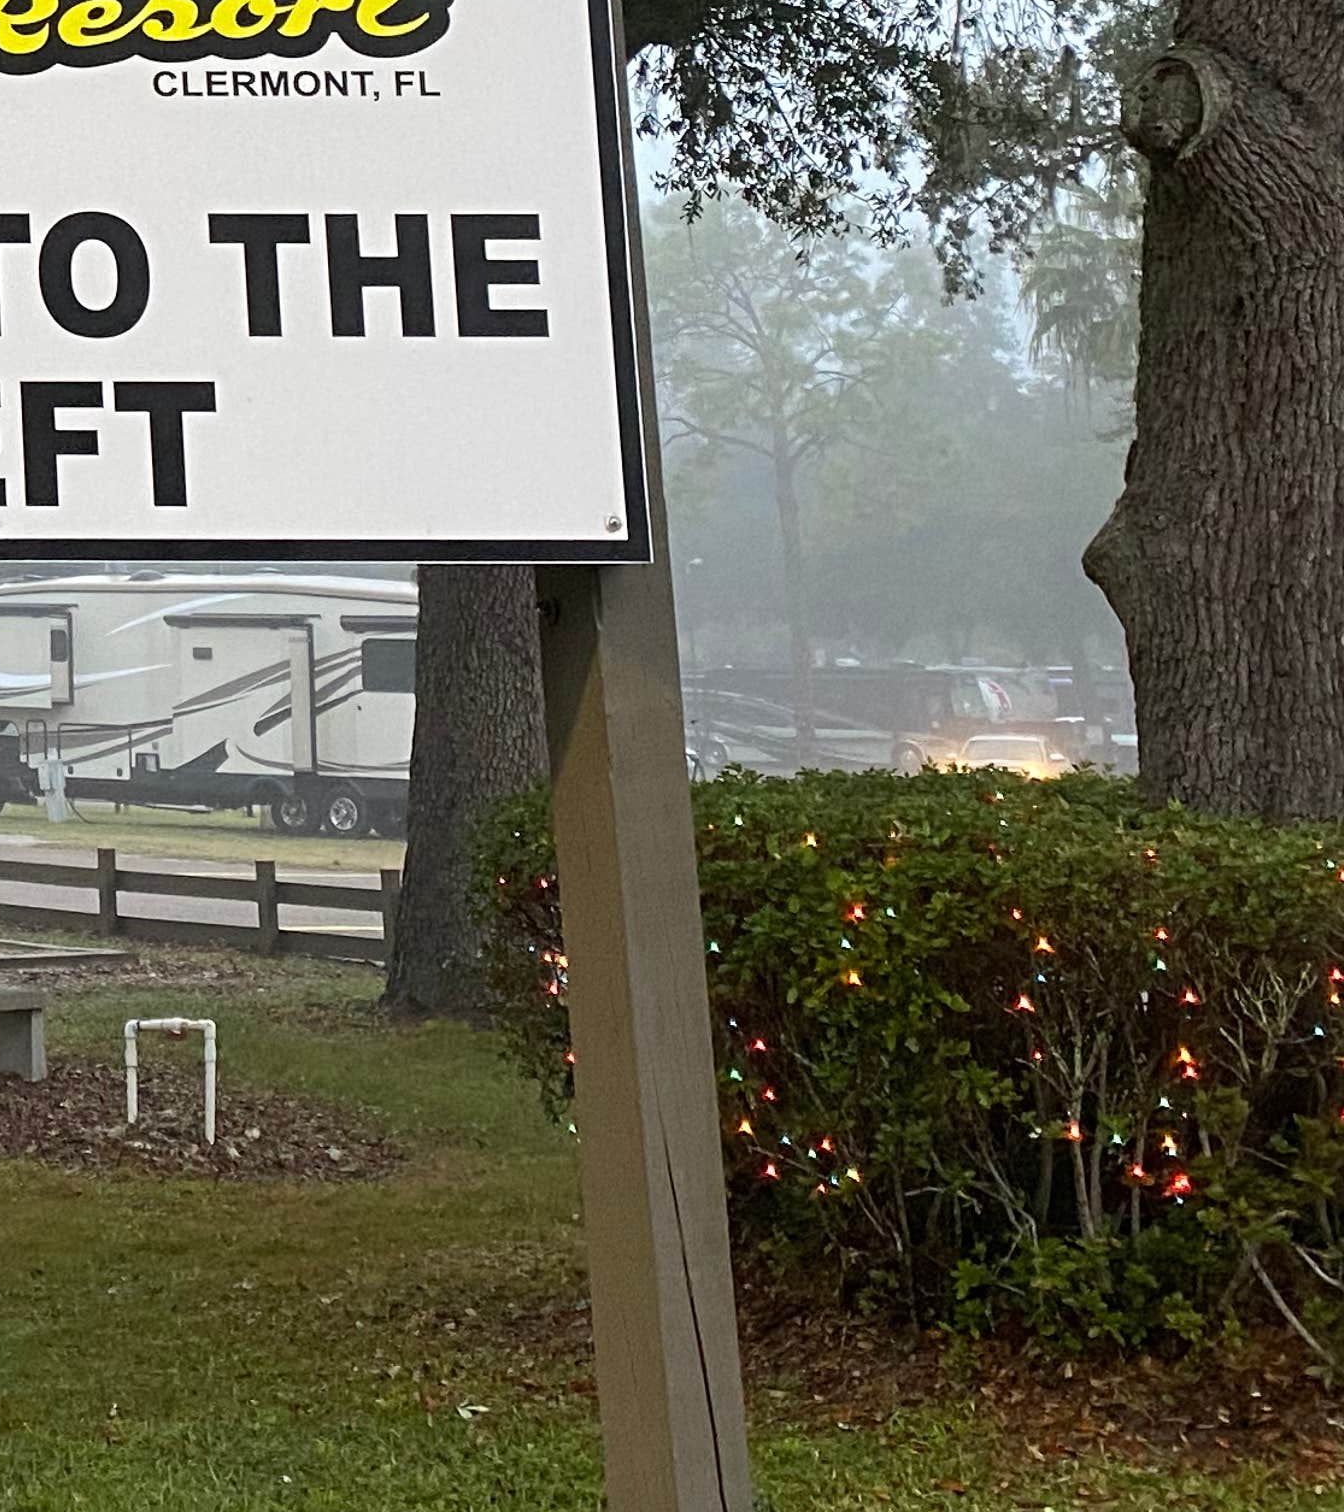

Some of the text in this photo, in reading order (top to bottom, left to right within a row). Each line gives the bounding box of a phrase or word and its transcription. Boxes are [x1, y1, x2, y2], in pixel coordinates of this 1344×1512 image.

[153, 69, 441, 102] CLERMONT, FL
[207, 213, 550, 338] THE
